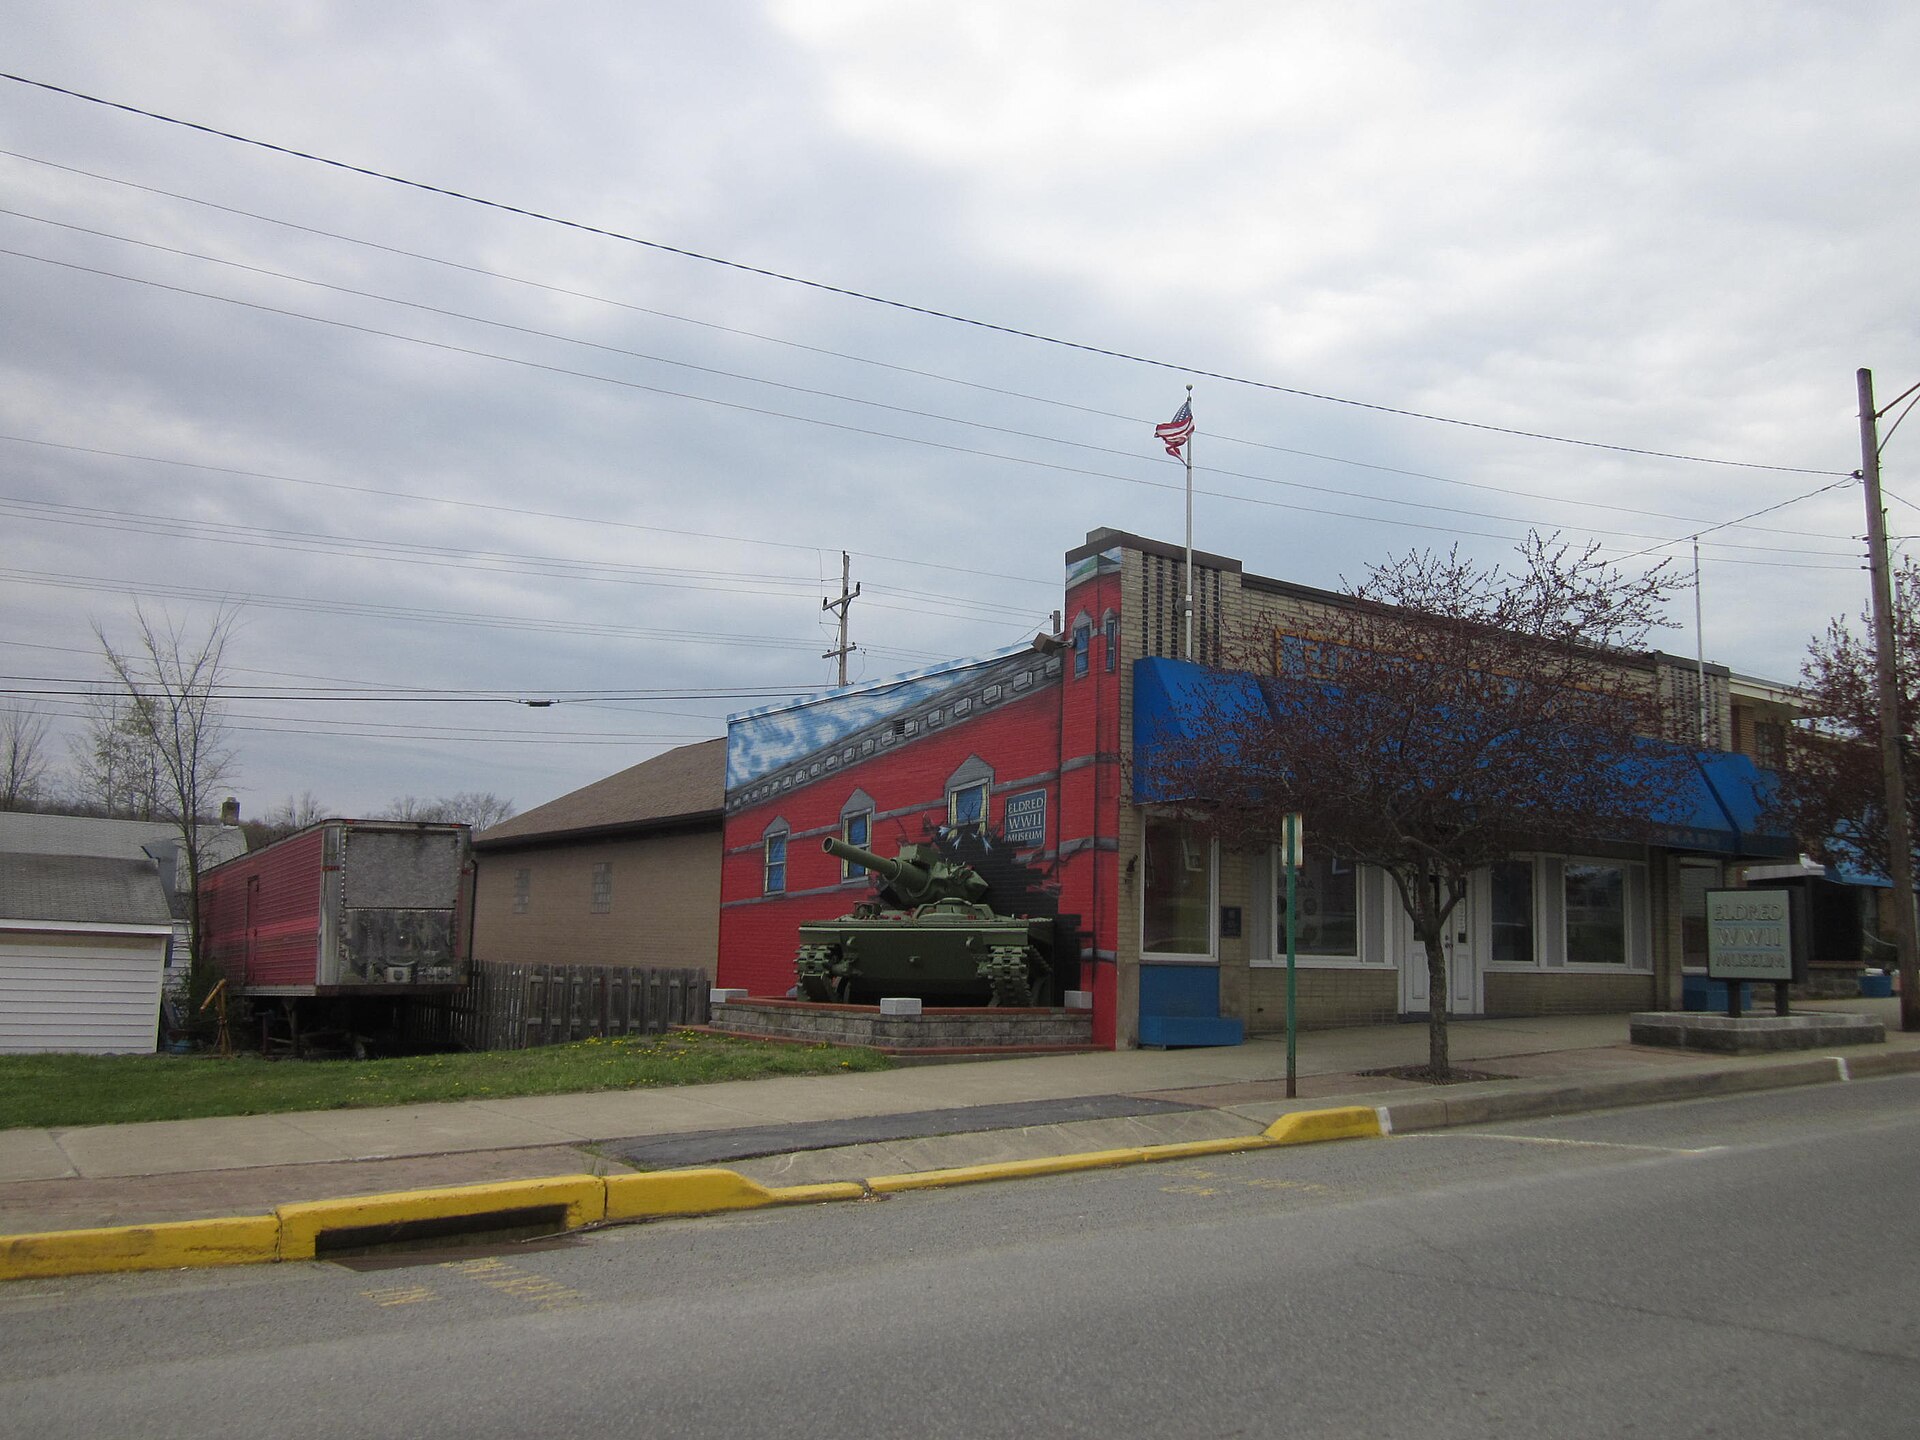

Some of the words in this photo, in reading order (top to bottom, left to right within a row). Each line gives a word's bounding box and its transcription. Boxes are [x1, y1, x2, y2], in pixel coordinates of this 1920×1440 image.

[1008, 798, 1043, 814] ELDRED
[1009, 814, 1041, 829] WWII
[1008, 830, 1042, 841] MUSEUM
[1714, 904, 1784, 921] ELDRED
[1715, 927, 1782, 947] WWII
[1715, 952, 1786, 969] MUSEUM
